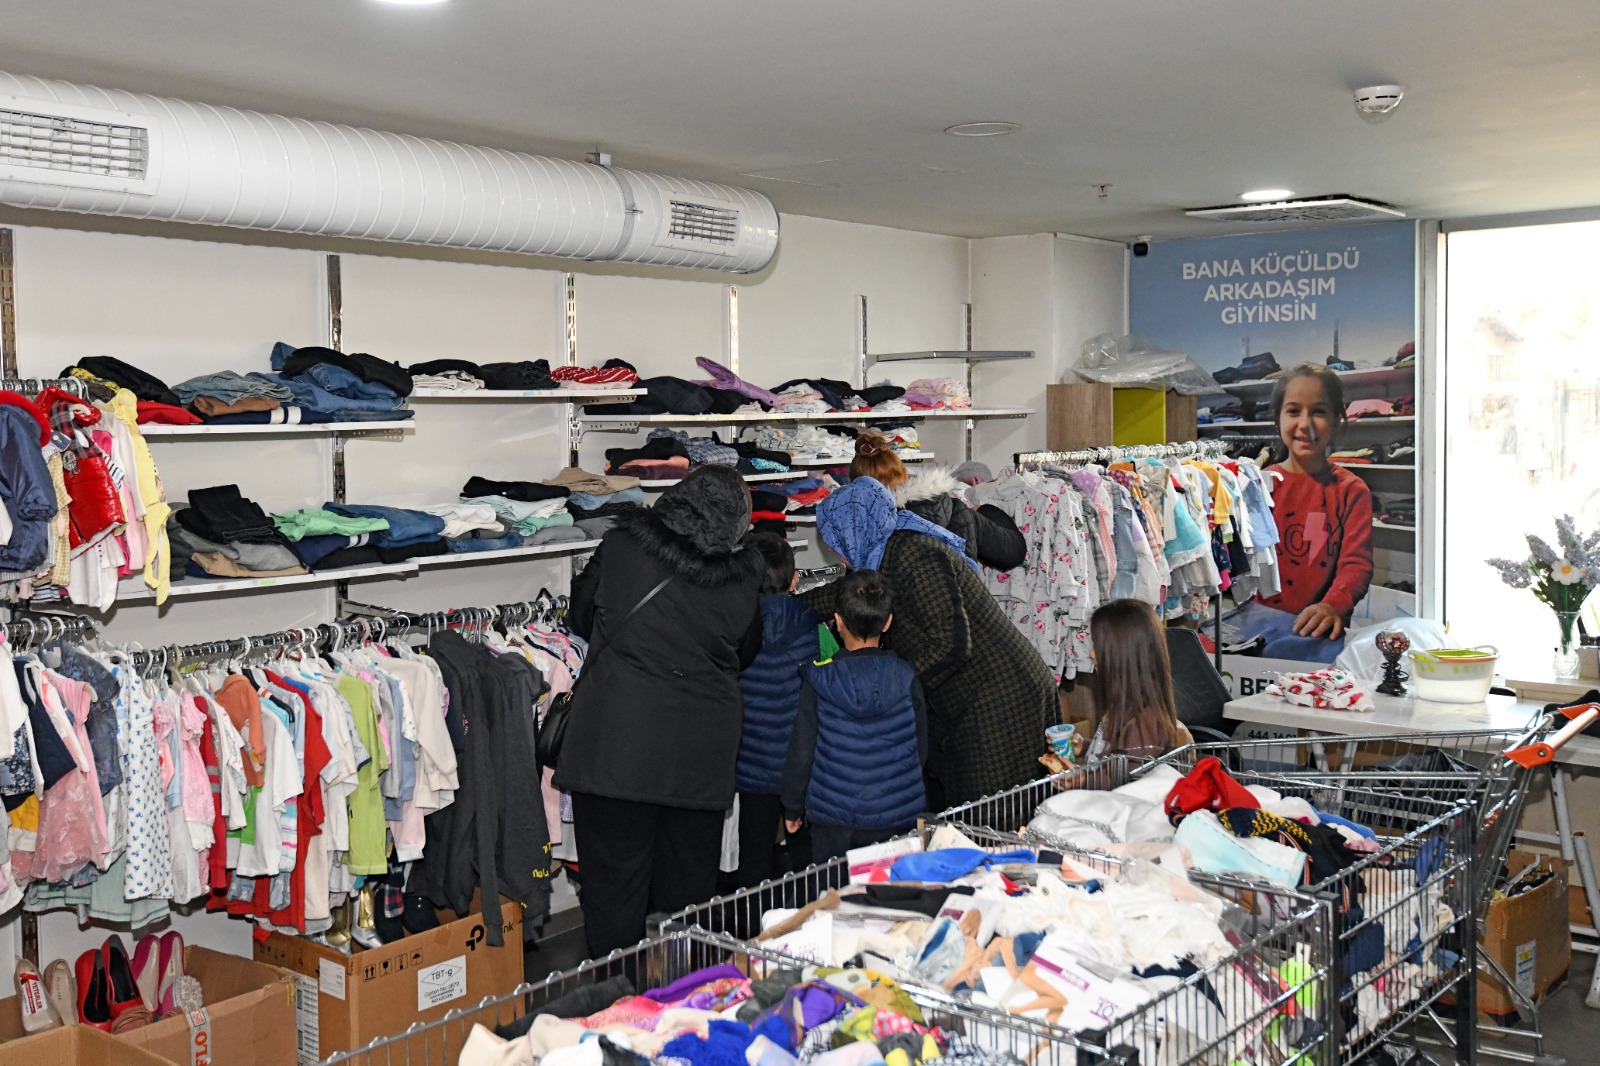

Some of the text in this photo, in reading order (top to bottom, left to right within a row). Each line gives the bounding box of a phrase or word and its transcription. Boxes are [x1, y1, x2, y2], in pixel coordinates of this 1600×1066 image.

[1182, 246, 1360, 280] BANA KÜÇÜLDÜ
[1203, 277, 1336, 302] ARKADAŞIM
[1221, 299, 1317, 325] GİYİNSİN
[1240, 676, 1275, 696] BE
